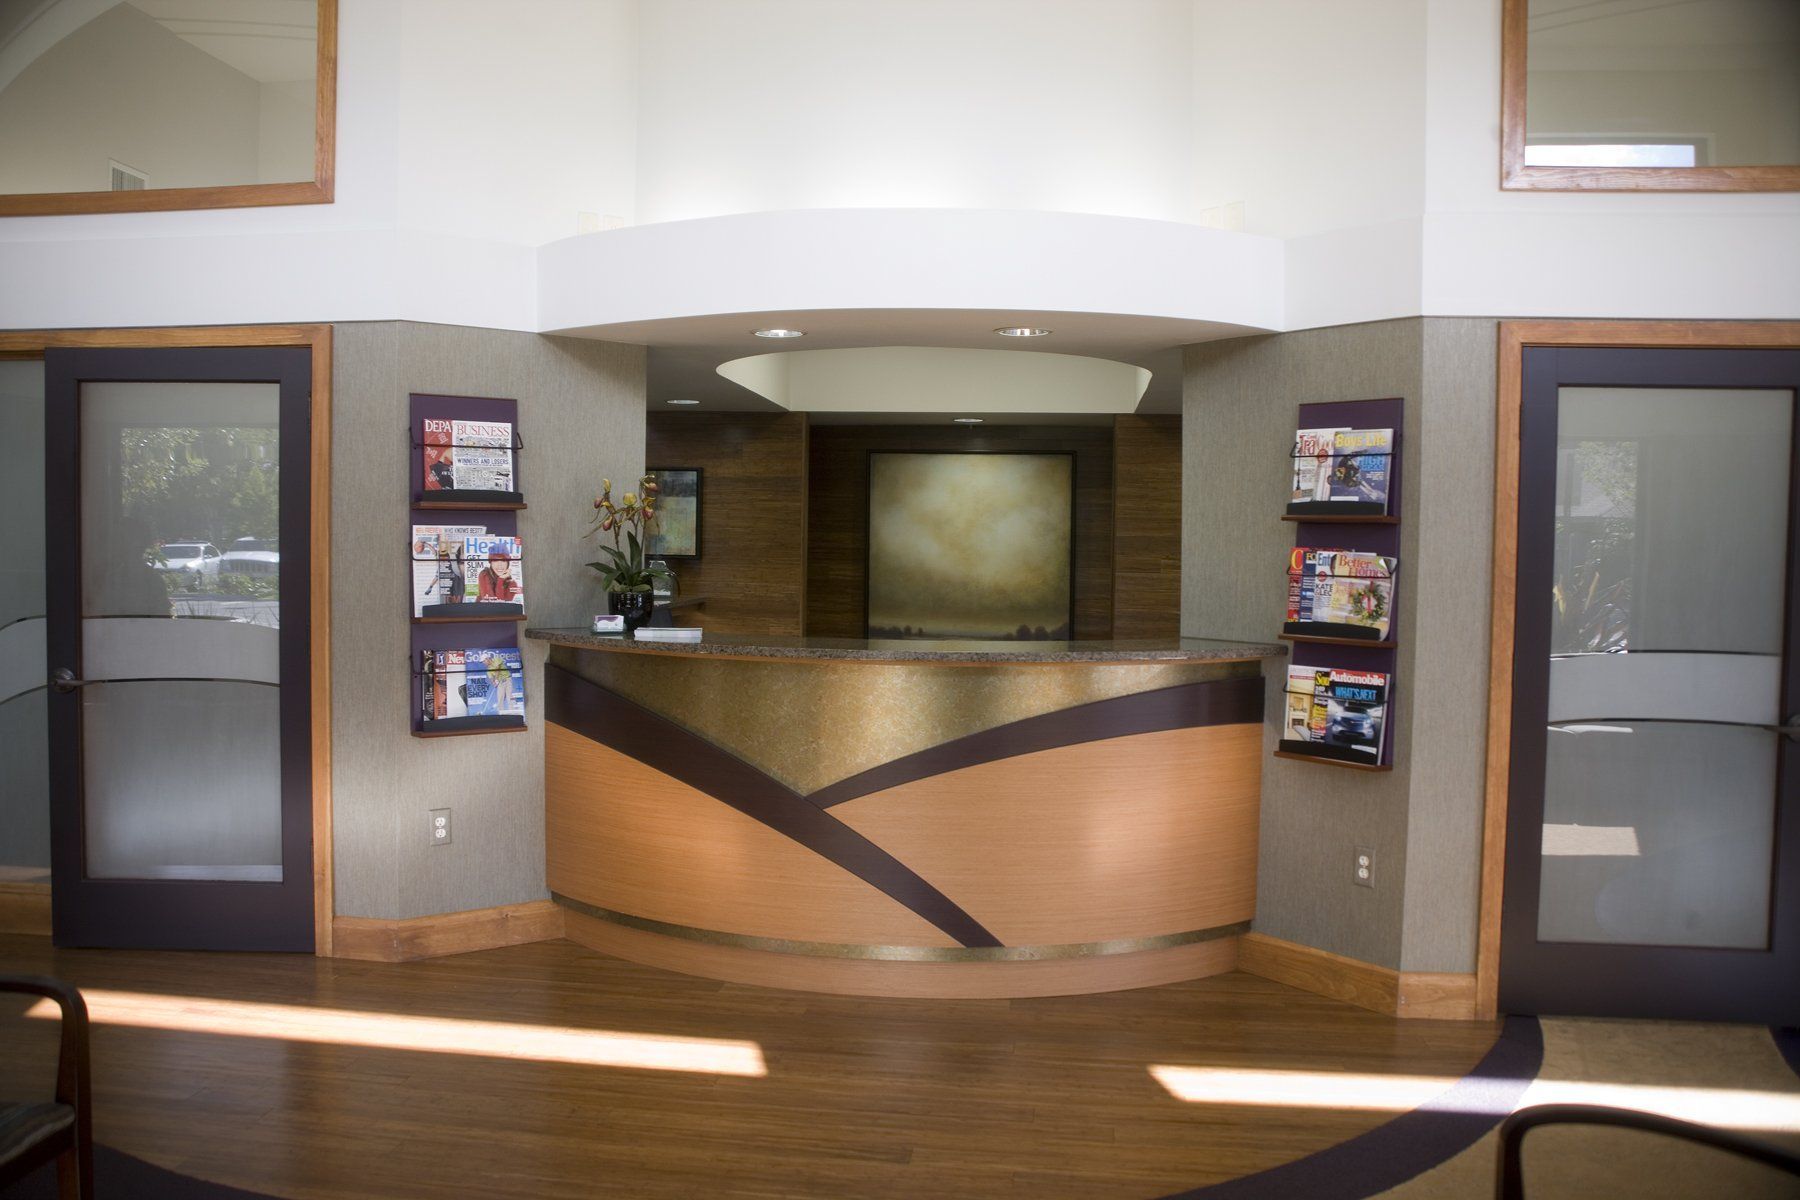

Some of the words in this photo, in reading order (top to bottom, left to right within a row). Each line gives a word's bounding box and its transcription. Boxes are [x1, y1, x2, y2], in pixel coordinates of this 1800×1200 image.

[457, 424, 510, 437] BUSINESS
[457, 458, 480, 466] WINNERS
[466, 537, 520, 554] Health
[1340, 554, 1372, 568] Better
[486, 650, 521, 663] Digest
[1330, 671, 1385, 686] Automobile
